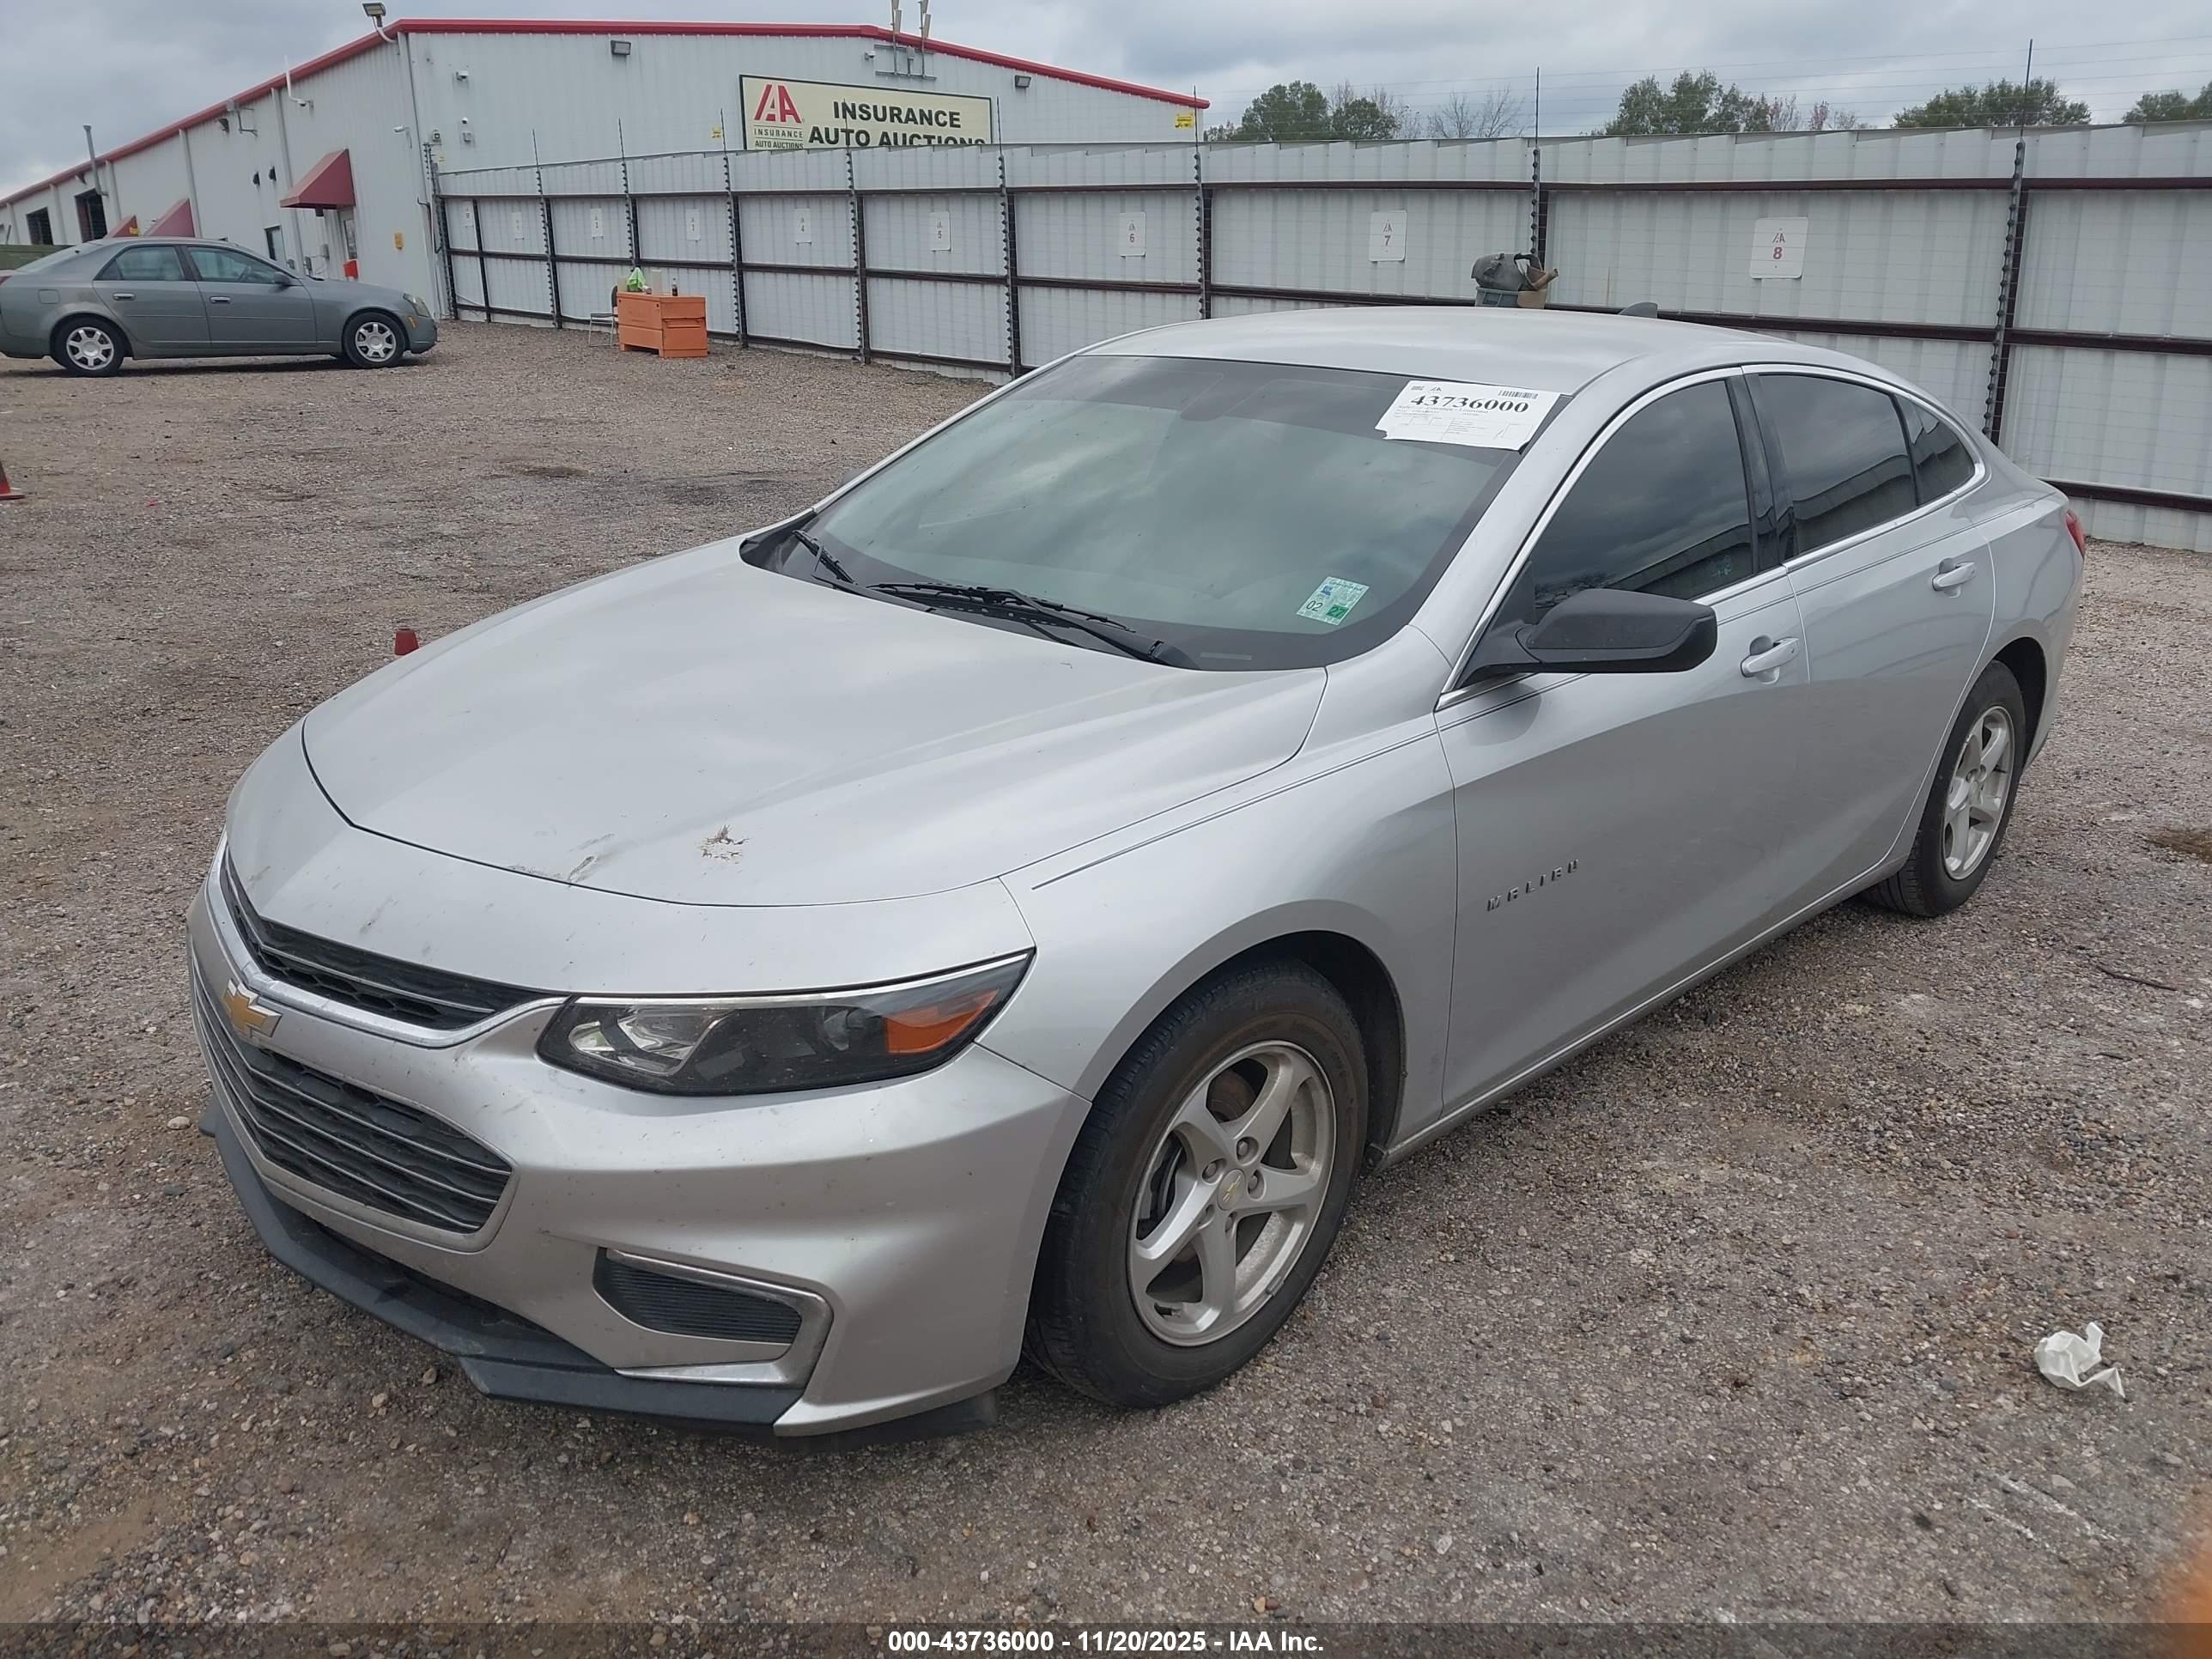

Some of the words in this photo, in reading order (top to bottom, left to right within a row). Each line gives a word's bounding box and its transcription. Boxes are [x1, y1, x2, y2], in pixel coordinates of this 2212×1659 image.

[833, 100, 961, 129] INSURANCE
[754, 128, 804, 138] INSURANCE
[809, 125, 871, 147] AUTO
[755, 139, 772, 149] AUTO
[774, 140, 804, 149] AUCTIONS
[1129, 233, 1135, 243] 6
[1384, 234, 1391, 246] 7
[1772, 246, 1784, 260] 8
[1410, 394, 1529, 413] 43736000
[1306, 599, 1324, 612] 02
[1326, 605, 1347, 618] 27
